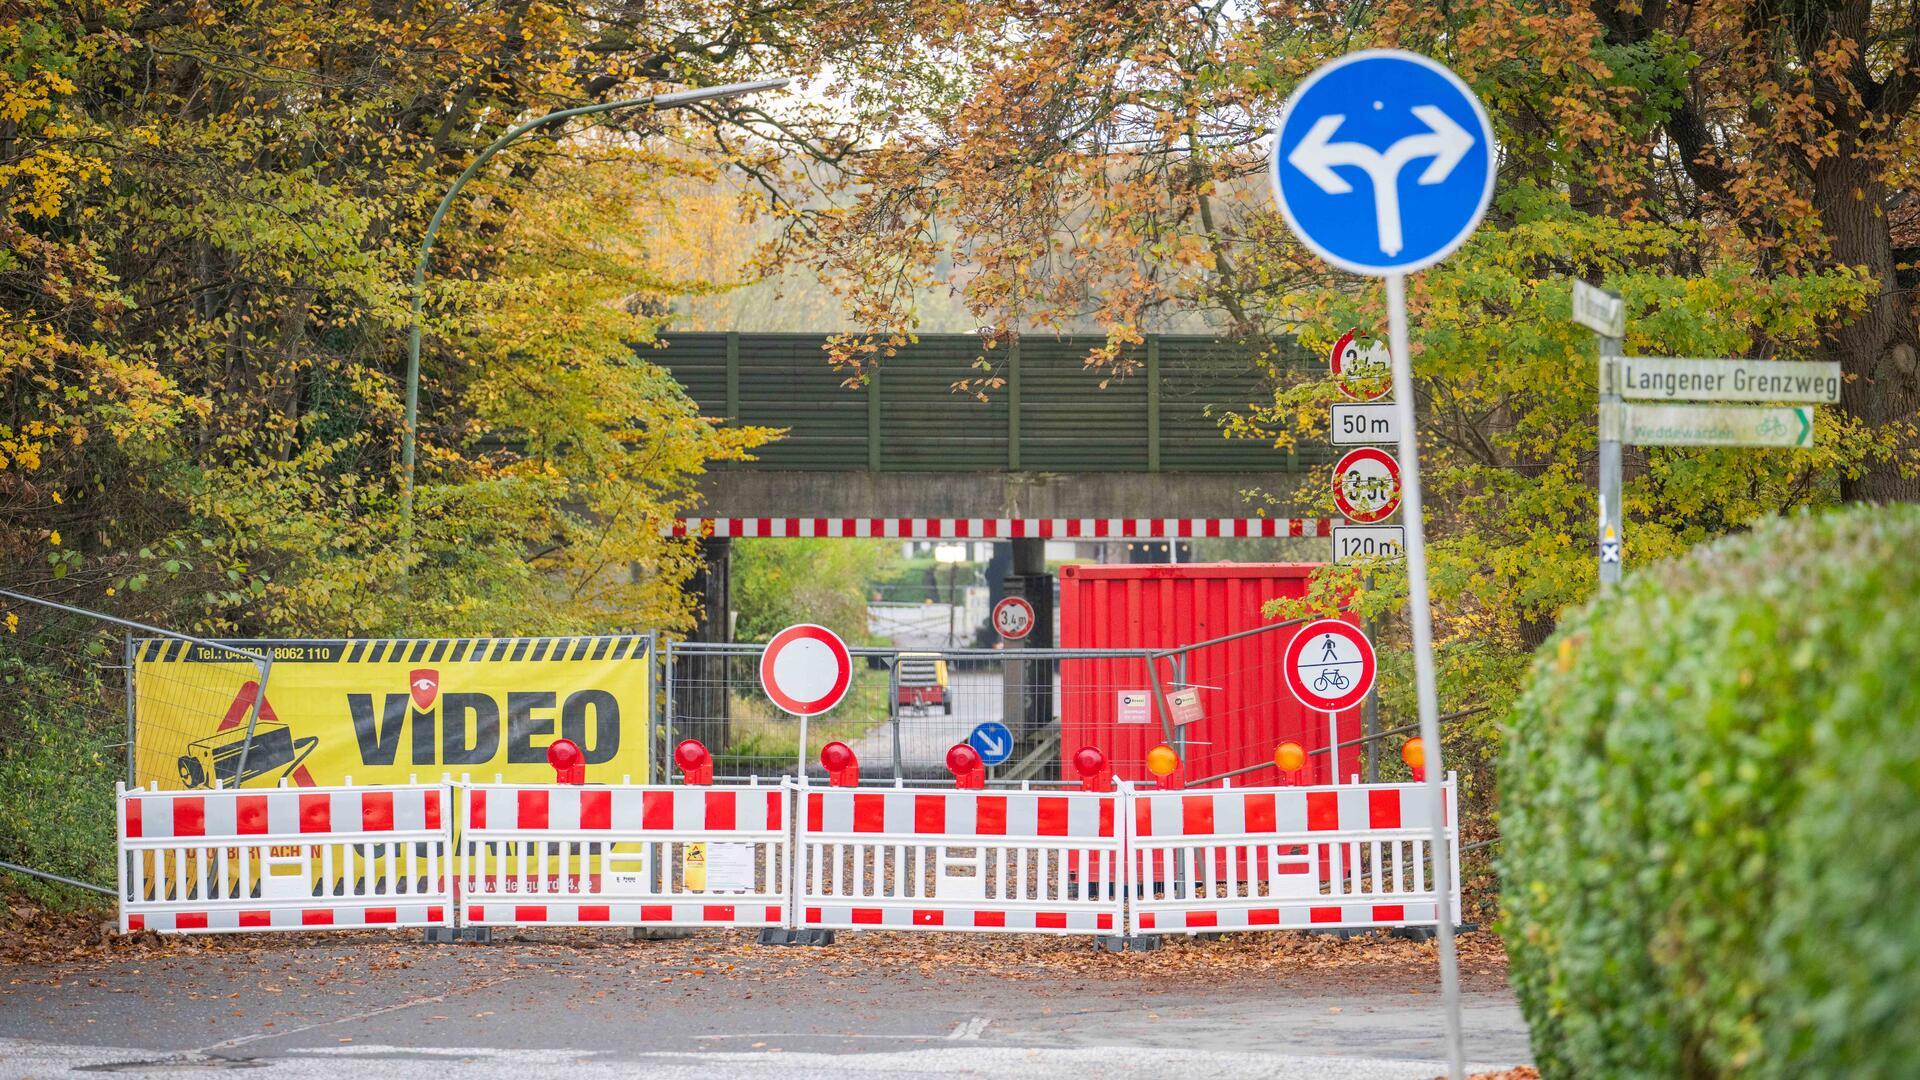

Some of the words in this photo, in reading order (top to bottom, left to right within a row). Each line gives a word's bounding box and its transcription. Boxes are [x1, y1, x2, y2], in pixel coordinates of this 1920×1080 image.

[1626, 365, 1726, 396] Langener
[1733, 368, 1838, 401] Grenzweg
[1343, 414, 1366, 434] 50
[1371, 418, 1389, 433] m
[1341, 537, 1374, 557] 120
[196, 647, 221, 660] Tel.:
[274, 647, 304, 660] 8062
[307, 646, 330, 660] 110
